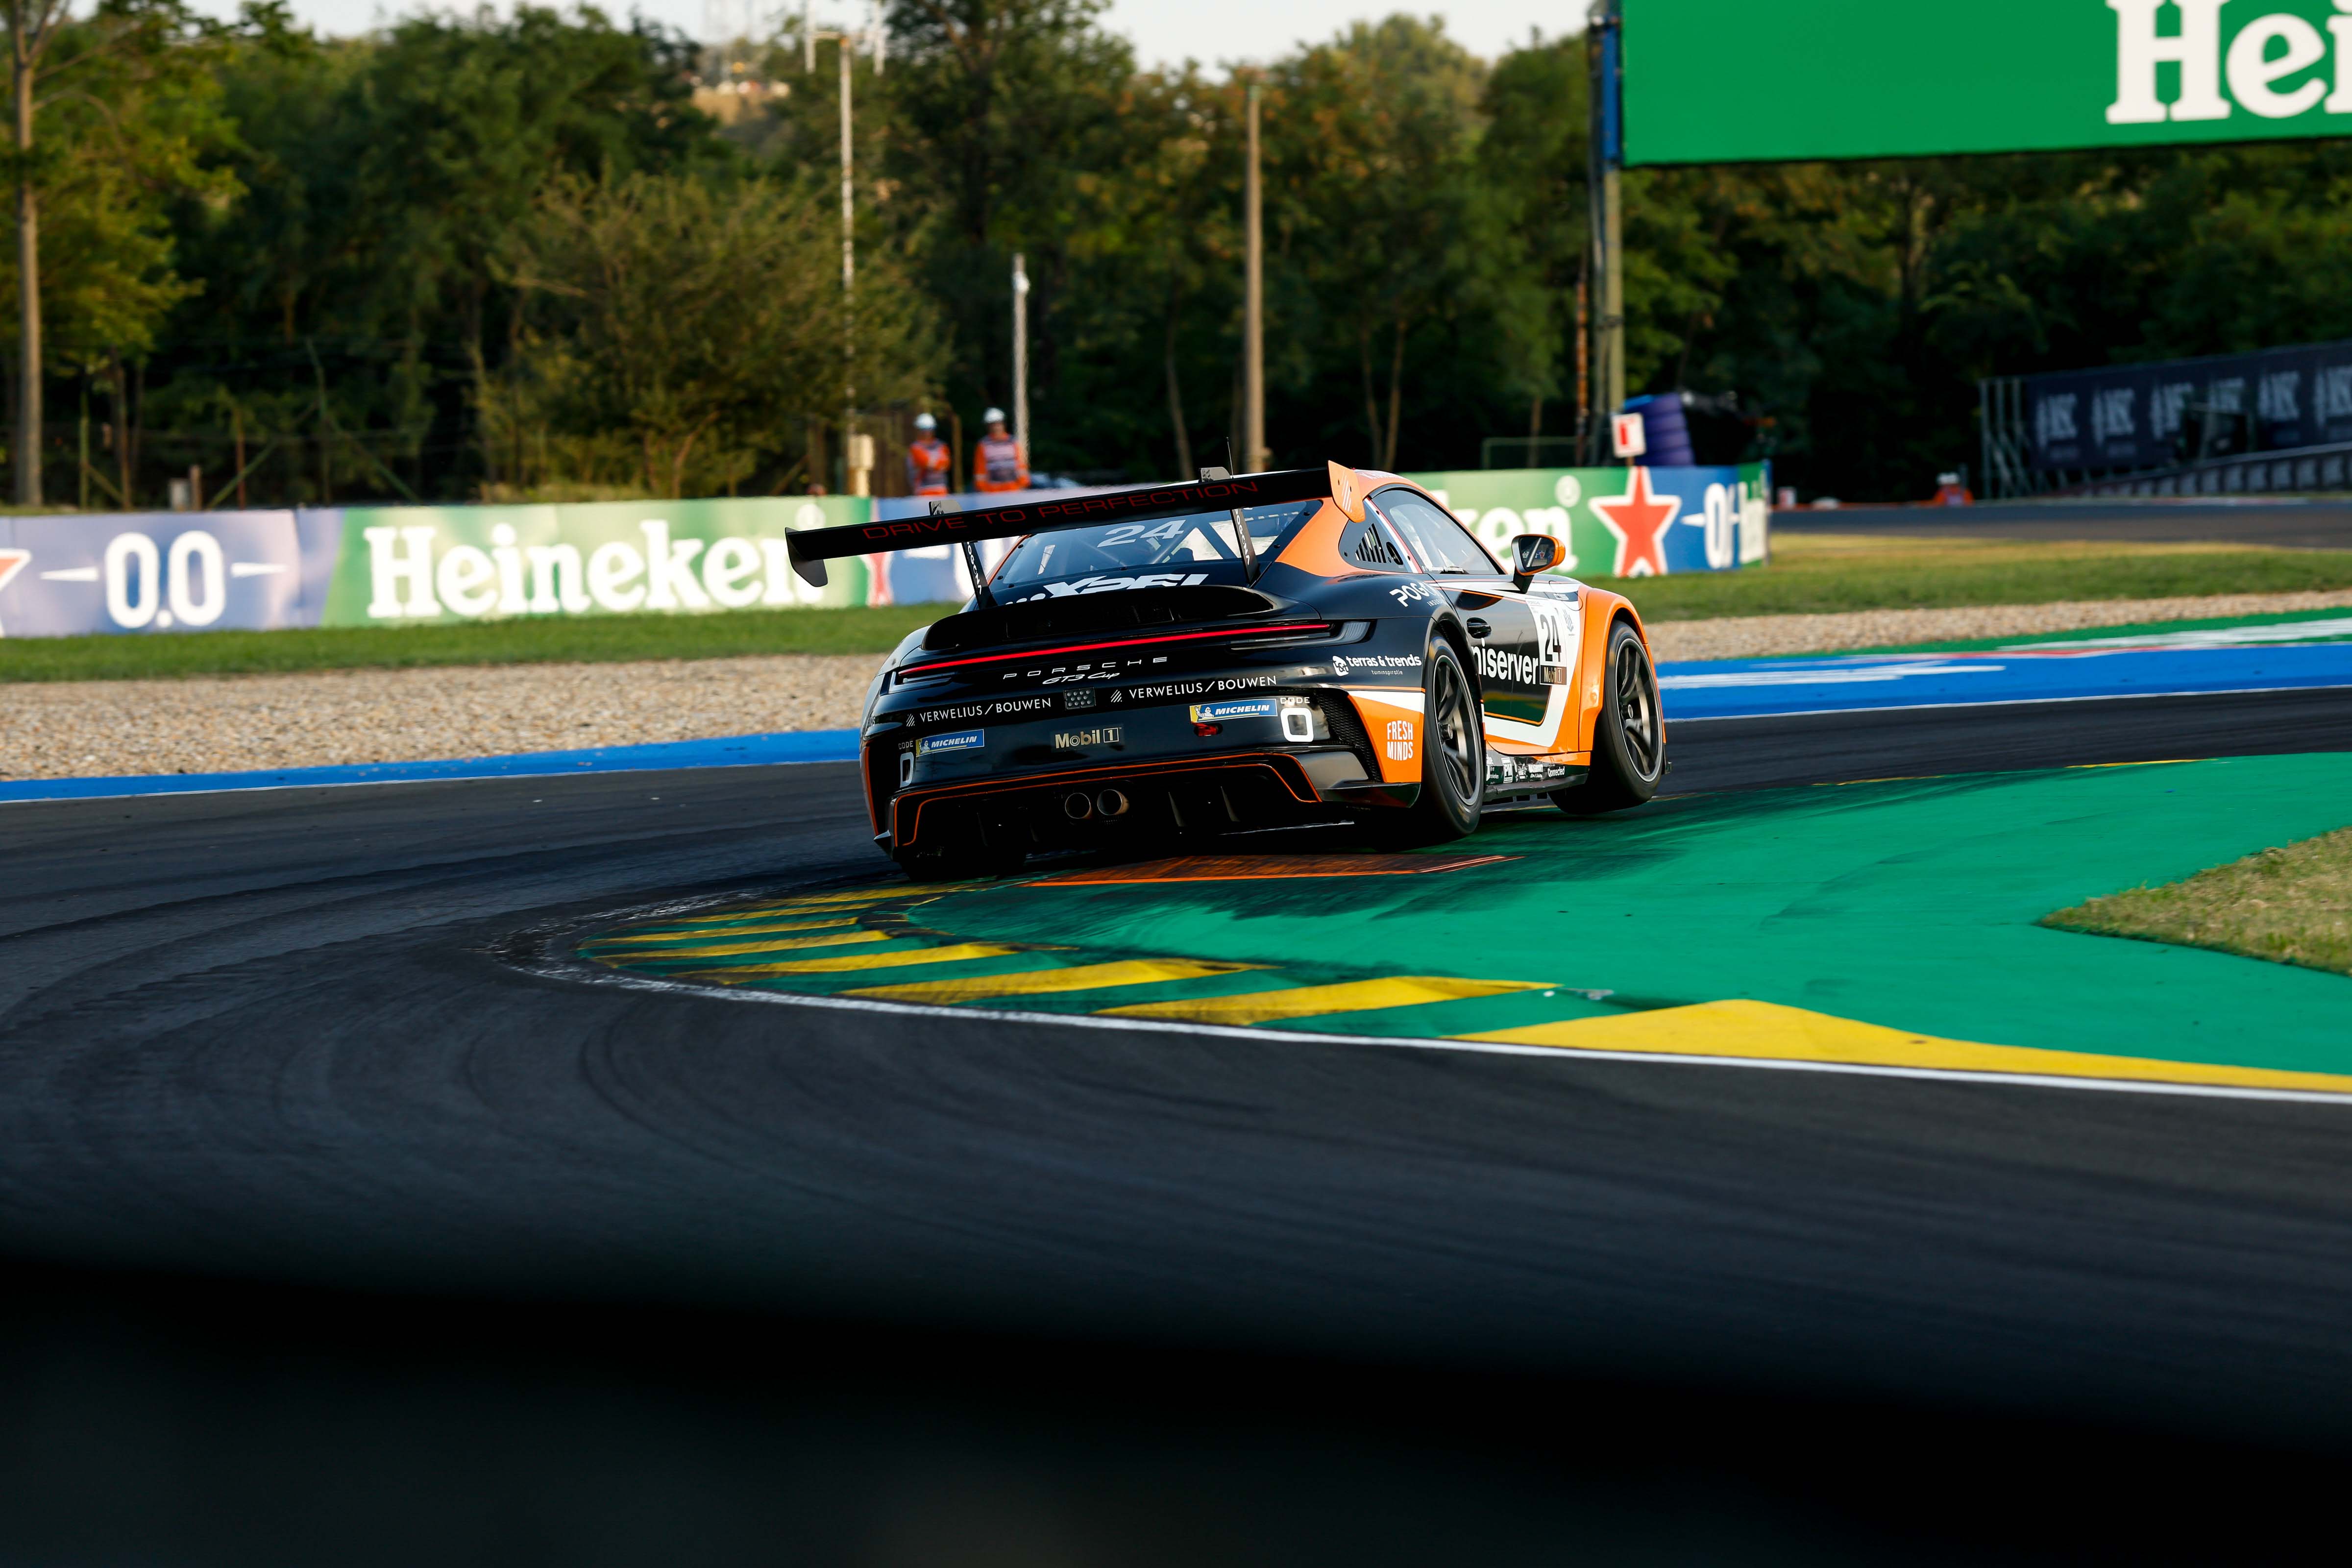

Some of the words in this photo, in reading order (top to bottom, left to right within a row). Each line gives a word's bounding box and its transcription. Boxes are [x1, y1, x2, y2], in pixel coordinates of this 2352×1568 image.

[862, 516, 967, 539] DRIVE
[976, 510, 1027, 524] TO
[1037, 481, 1258, 518] PERFECTION
[1097, 519, 1186, 548] 24
[105, 531, 226, 629] 0.0
[1540, 614, 1562, 662] 24
[1003, 657, 1167, 680] PORSCHE
[1346, 656, 1379, 667] terras
[1377, 655, 1385, 667] &
[1384, 654, 1422, 667] trends
[1470, 637, 1539, 685] niserver
[1042, 674, 1085, 685] GT3
[1087, 671, 1120, 680] Cup
[1544, 666, 1557, 683] Mobil
[1215, 704, 1270, 715] MICHELIN
[1055, 729, 1101, 749] Mobil
[1387, 720, 1413, 740] FRESH
[898, 740, 913, 750] CODE
[931, 735, 977, 748] MICHELIN
[1387, 741, 1413, 761] MINDS
[1547, 766, 1565, 778] Qonnected
